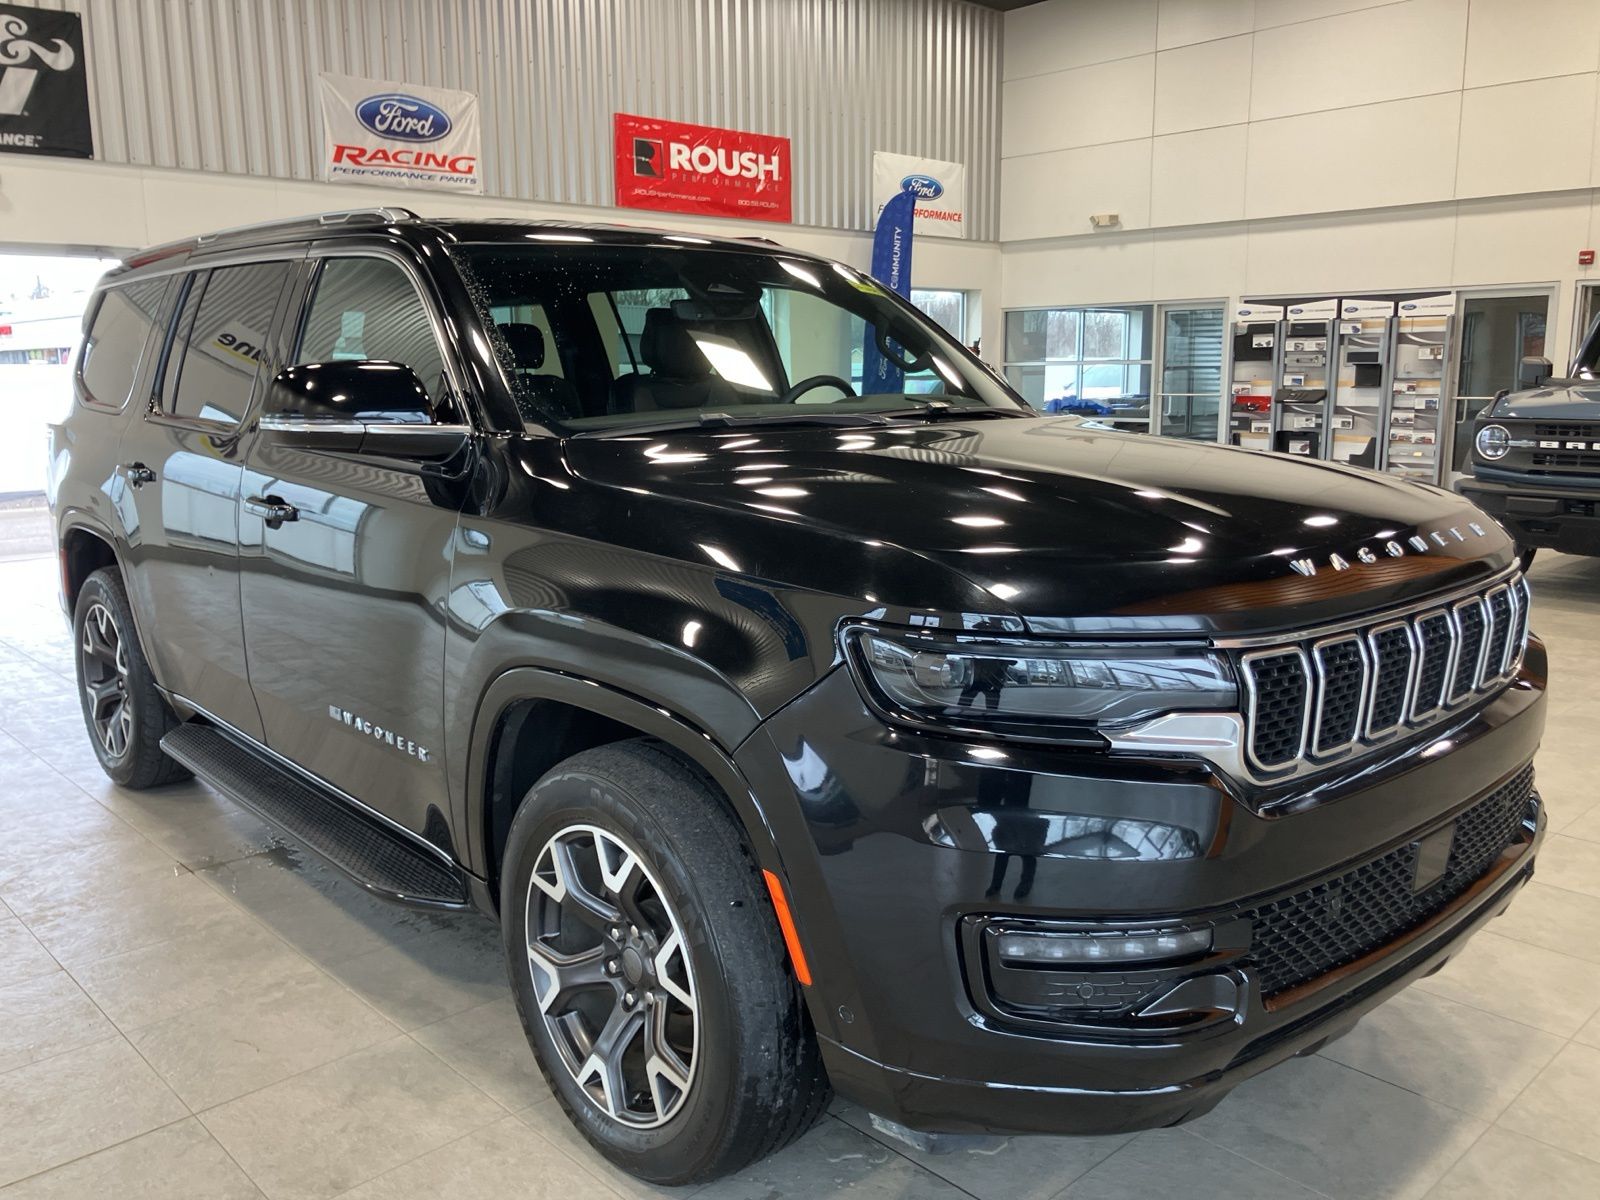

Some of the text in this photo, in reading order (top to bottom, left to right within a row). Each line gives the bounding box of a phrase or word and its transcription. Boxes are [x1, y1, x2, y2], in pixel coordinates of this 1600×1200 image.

[374, 101, 435, 136] Ford
[332, 144, 476, 174] RACING
[333, 166, 477, 185] PERFORMANCE PARTS
[670, 142, 780, 181] ROUSH
[890, 227, 902, 289] COMMUNITY
[1289, 522, 1486, 577] WAGONEER
[342, 711, 430, 762] WAGONEER
